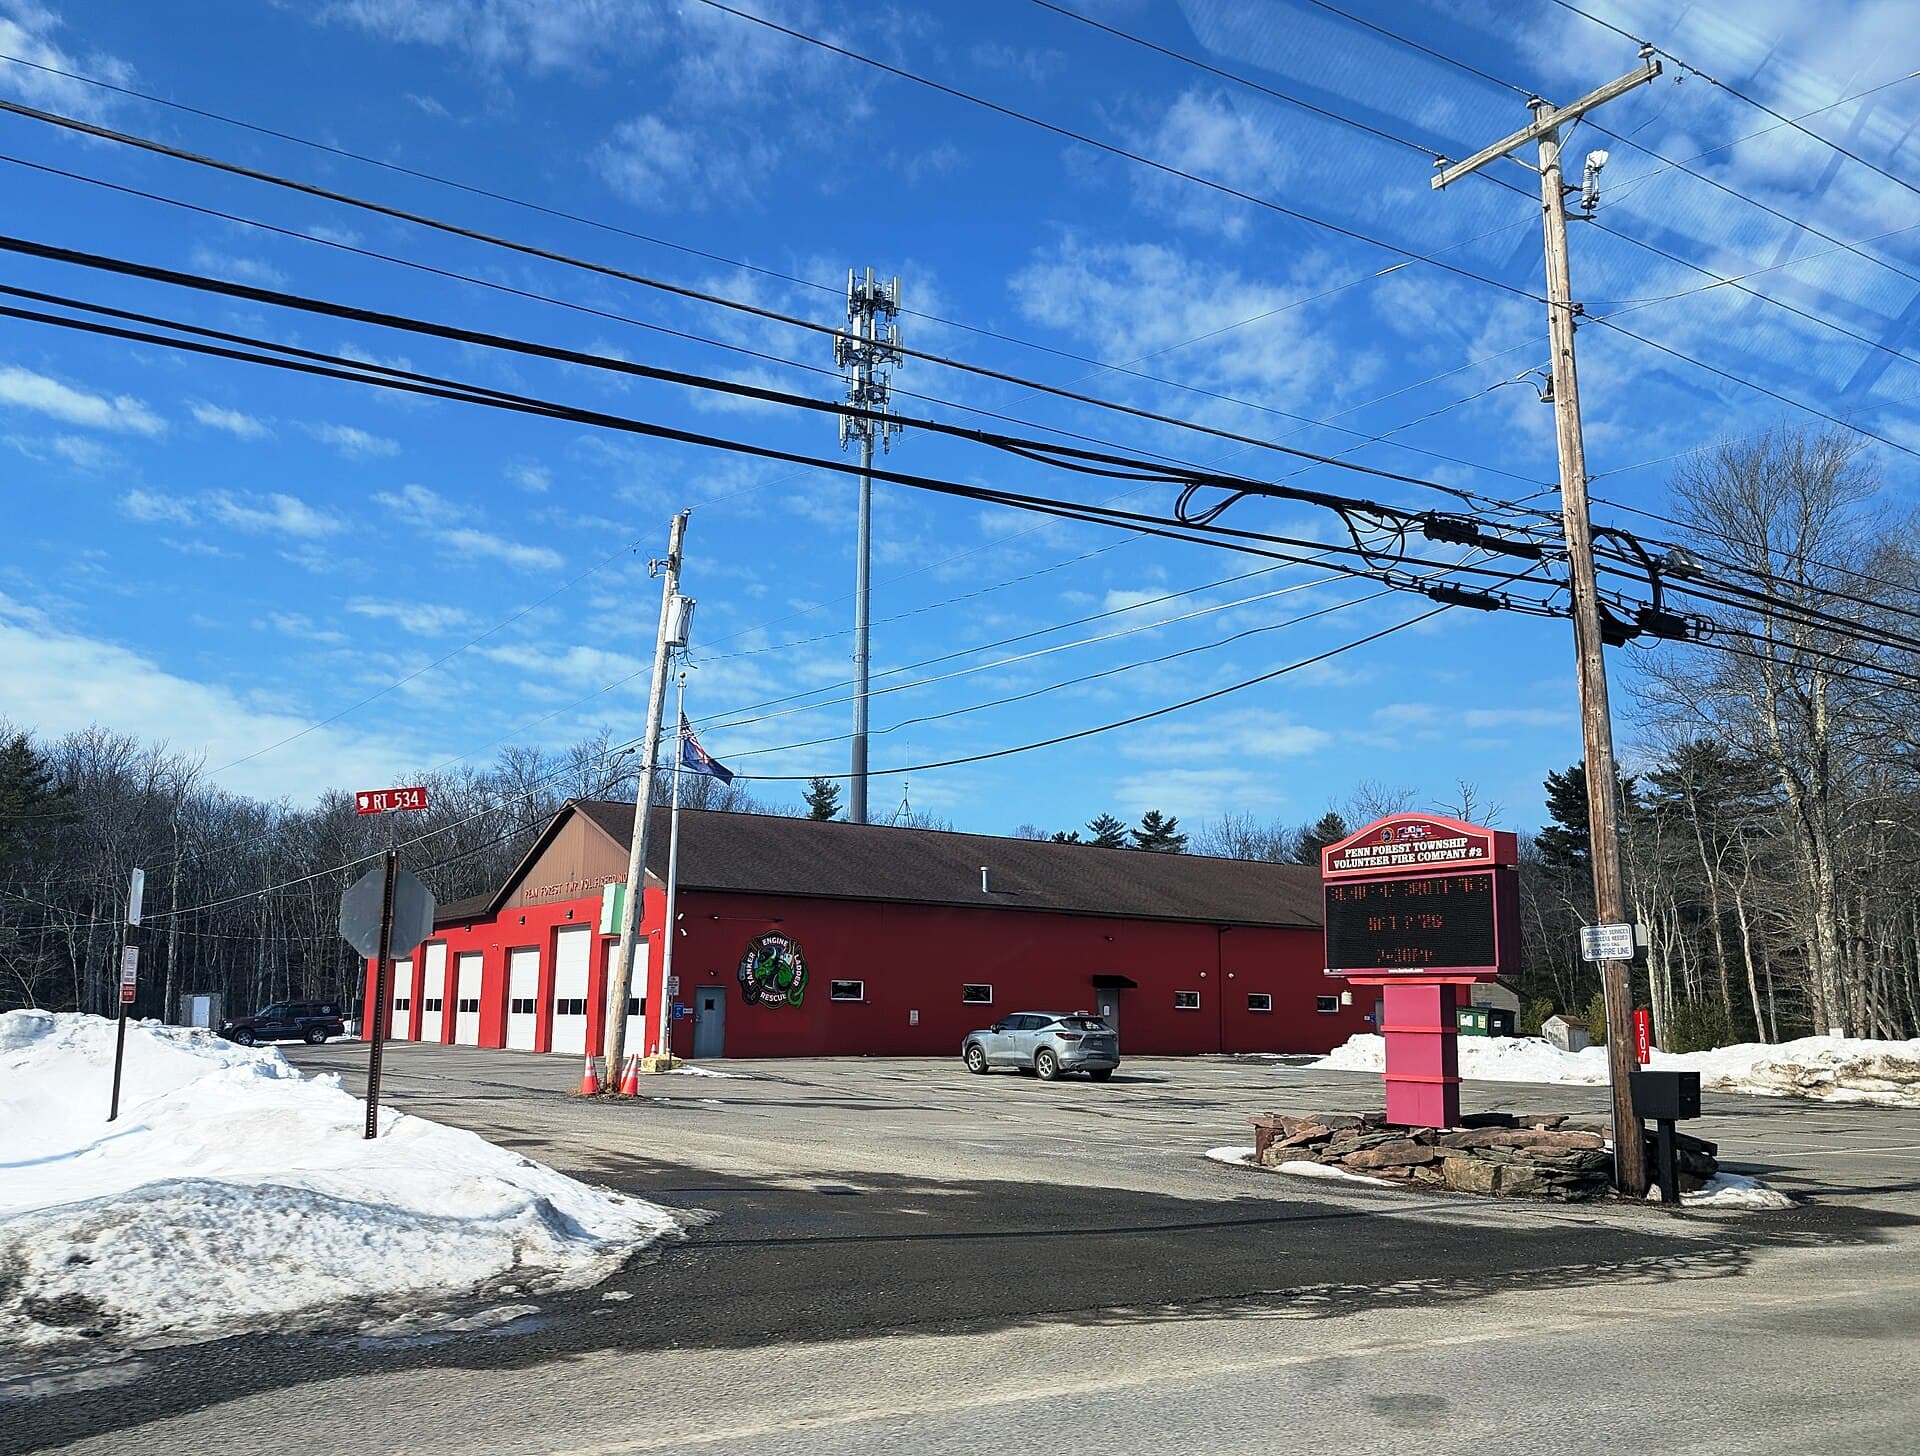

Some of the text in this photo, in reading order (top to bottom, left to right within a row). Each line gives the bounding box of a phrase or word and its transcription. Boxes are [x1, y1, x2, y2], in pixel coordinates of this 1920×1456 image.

[373, 791, 419, 809] RT 534
[1333, 847, 1483, 869] VOLUNTEER FIRE COMPANY #2
[1344, 837, 1468, 858] PENN FOREST TOWNSHIP
[761, 936, 789, 947] ENGINE
[1617, 946, 1630, 955] LINE
[745, 952, 756, 986] TANKER
[793, 953, 802, 987] LADDER
[759, 991, 787, 1002] RESCUE
[1638, 1011, 1647, 1063] 1507
